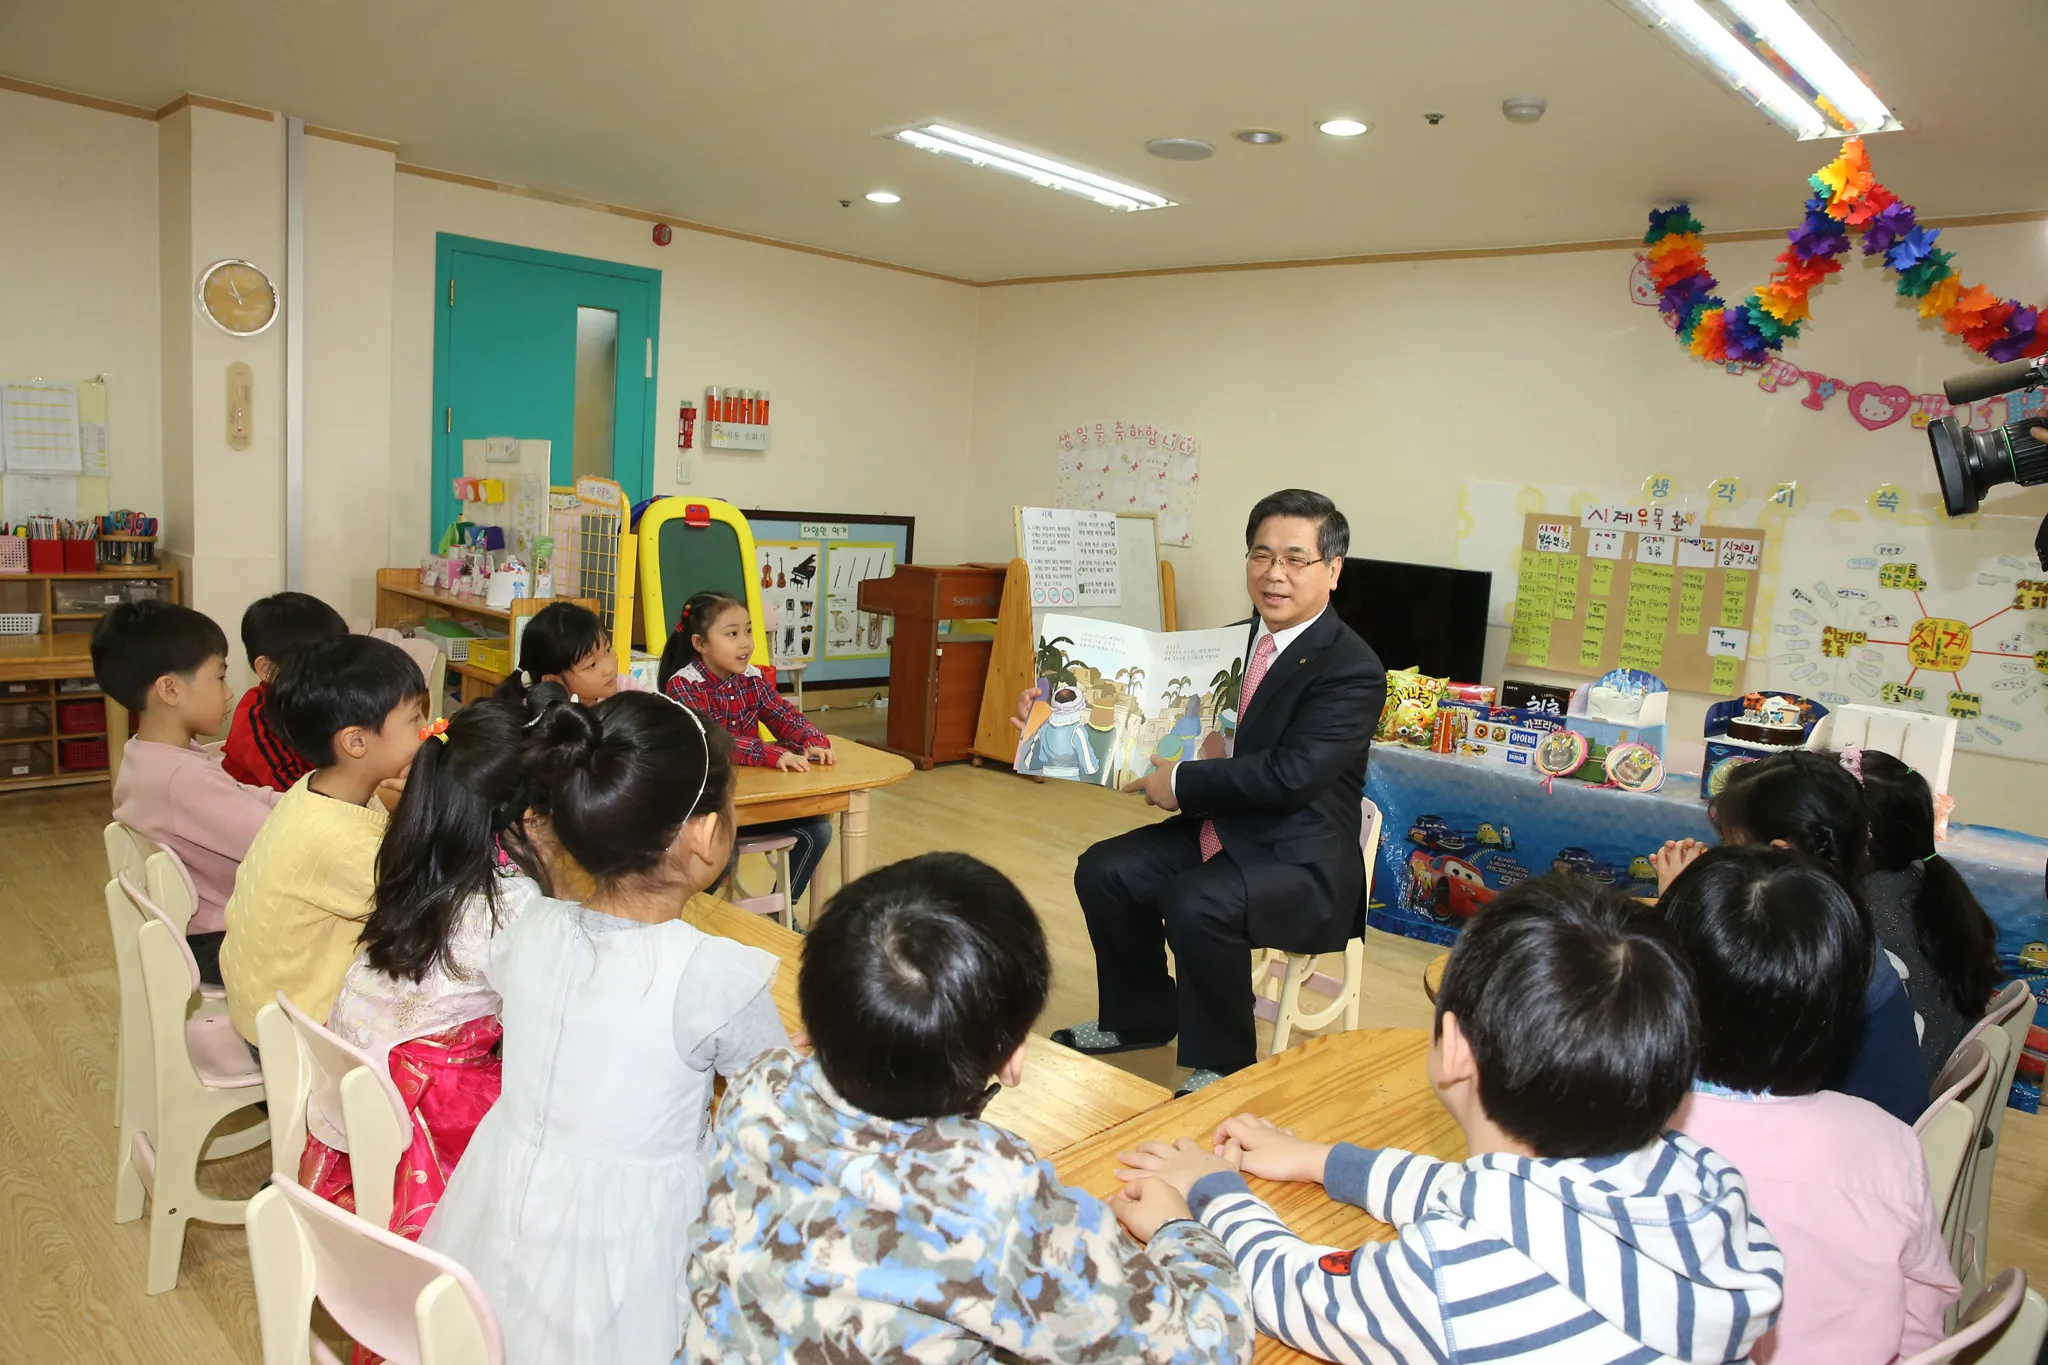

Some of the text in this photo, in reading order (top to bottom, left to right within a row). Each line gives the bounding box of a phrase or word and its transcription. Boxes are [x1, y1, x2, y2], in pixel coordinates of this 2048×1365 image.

[1059, 420, 1193, 455] 생일을 축하합니다
[1876, 491, 1899, 513] 쑥
[1041, 510, 1053, 519] 시계
[832, 526, 847, 537] 악기
[1909, 625, 1969, 651] 시계
[1511, 732, 1536, 745] 아이비
[1489, 860, 1529, 873] LIGHTNING
[1493, 855, 1517, 865] TEAM
